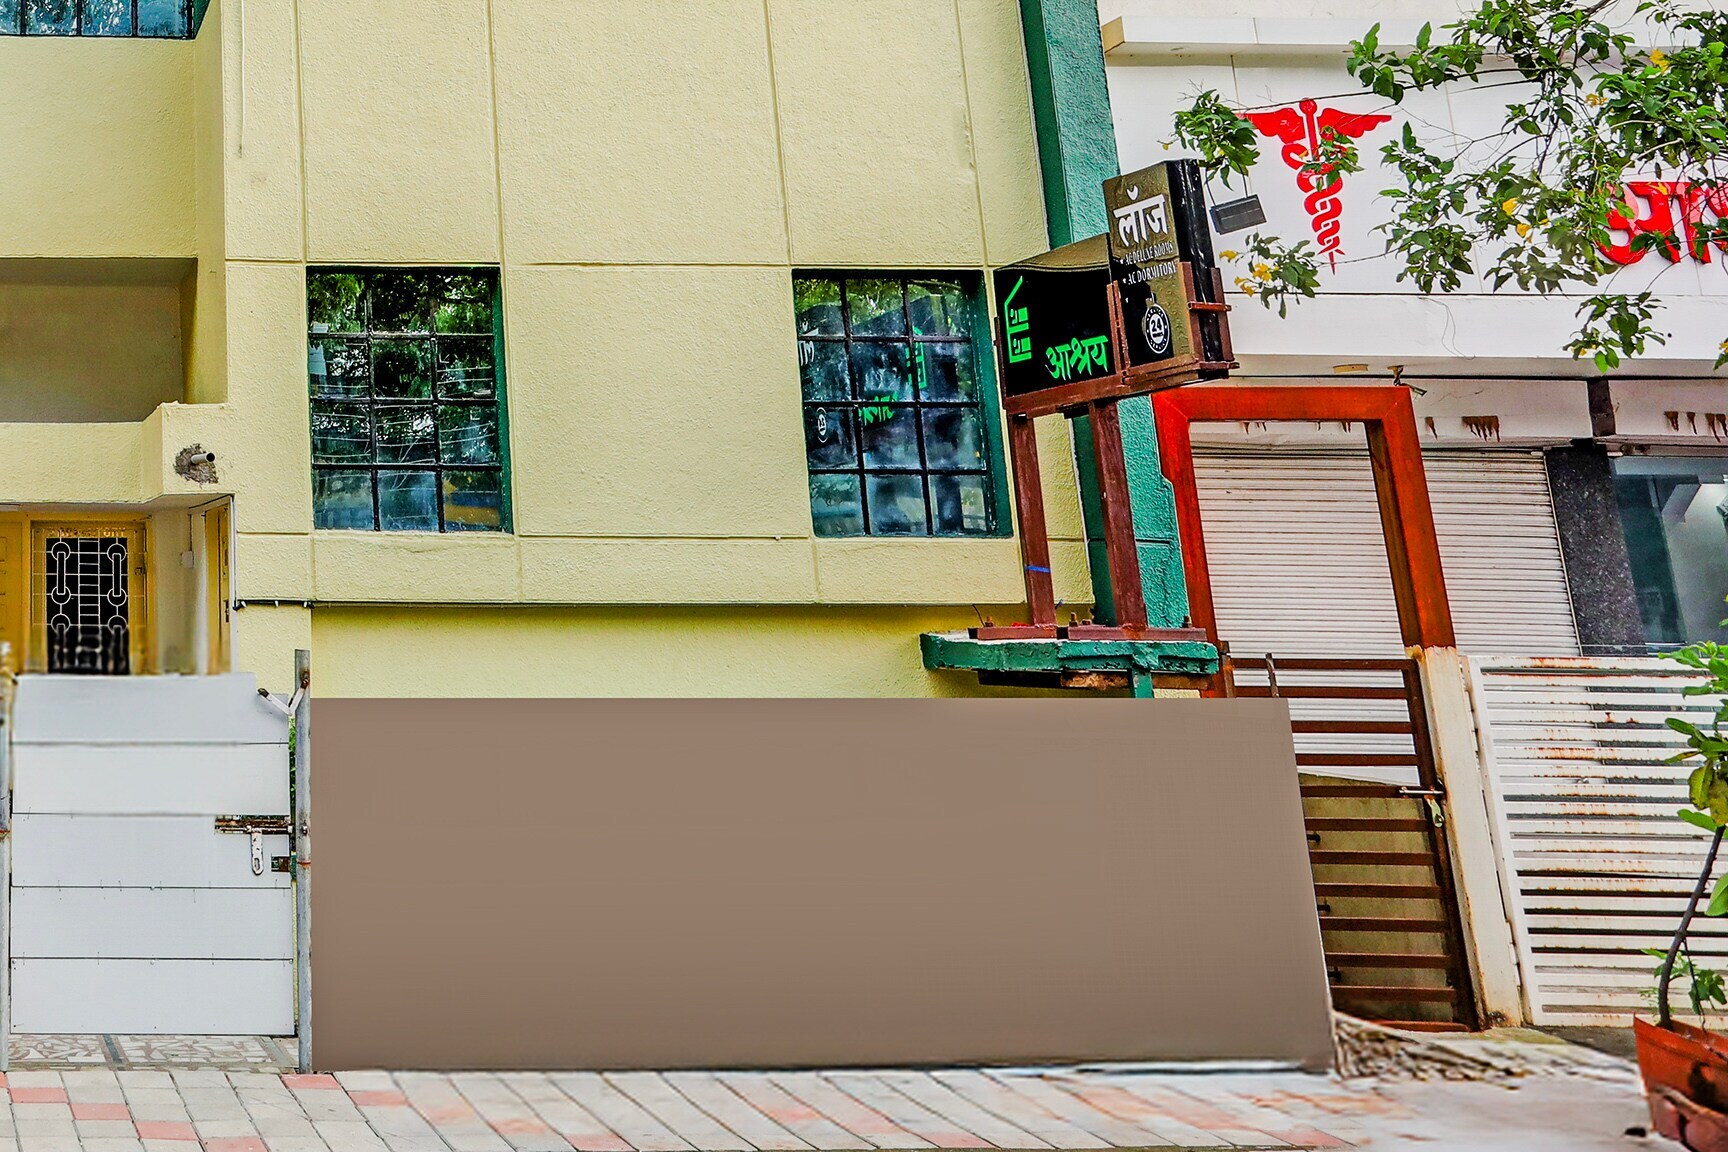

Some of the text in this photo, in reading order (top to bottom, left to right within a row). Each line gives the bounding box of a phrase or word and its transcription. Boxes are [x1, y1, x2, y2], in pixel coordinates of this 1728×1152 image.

[1113, 184, 1168, 247] लॉज
[1150, 317, 1164, 333] 24
[1045, 334, 1109, 381] आश्रय
